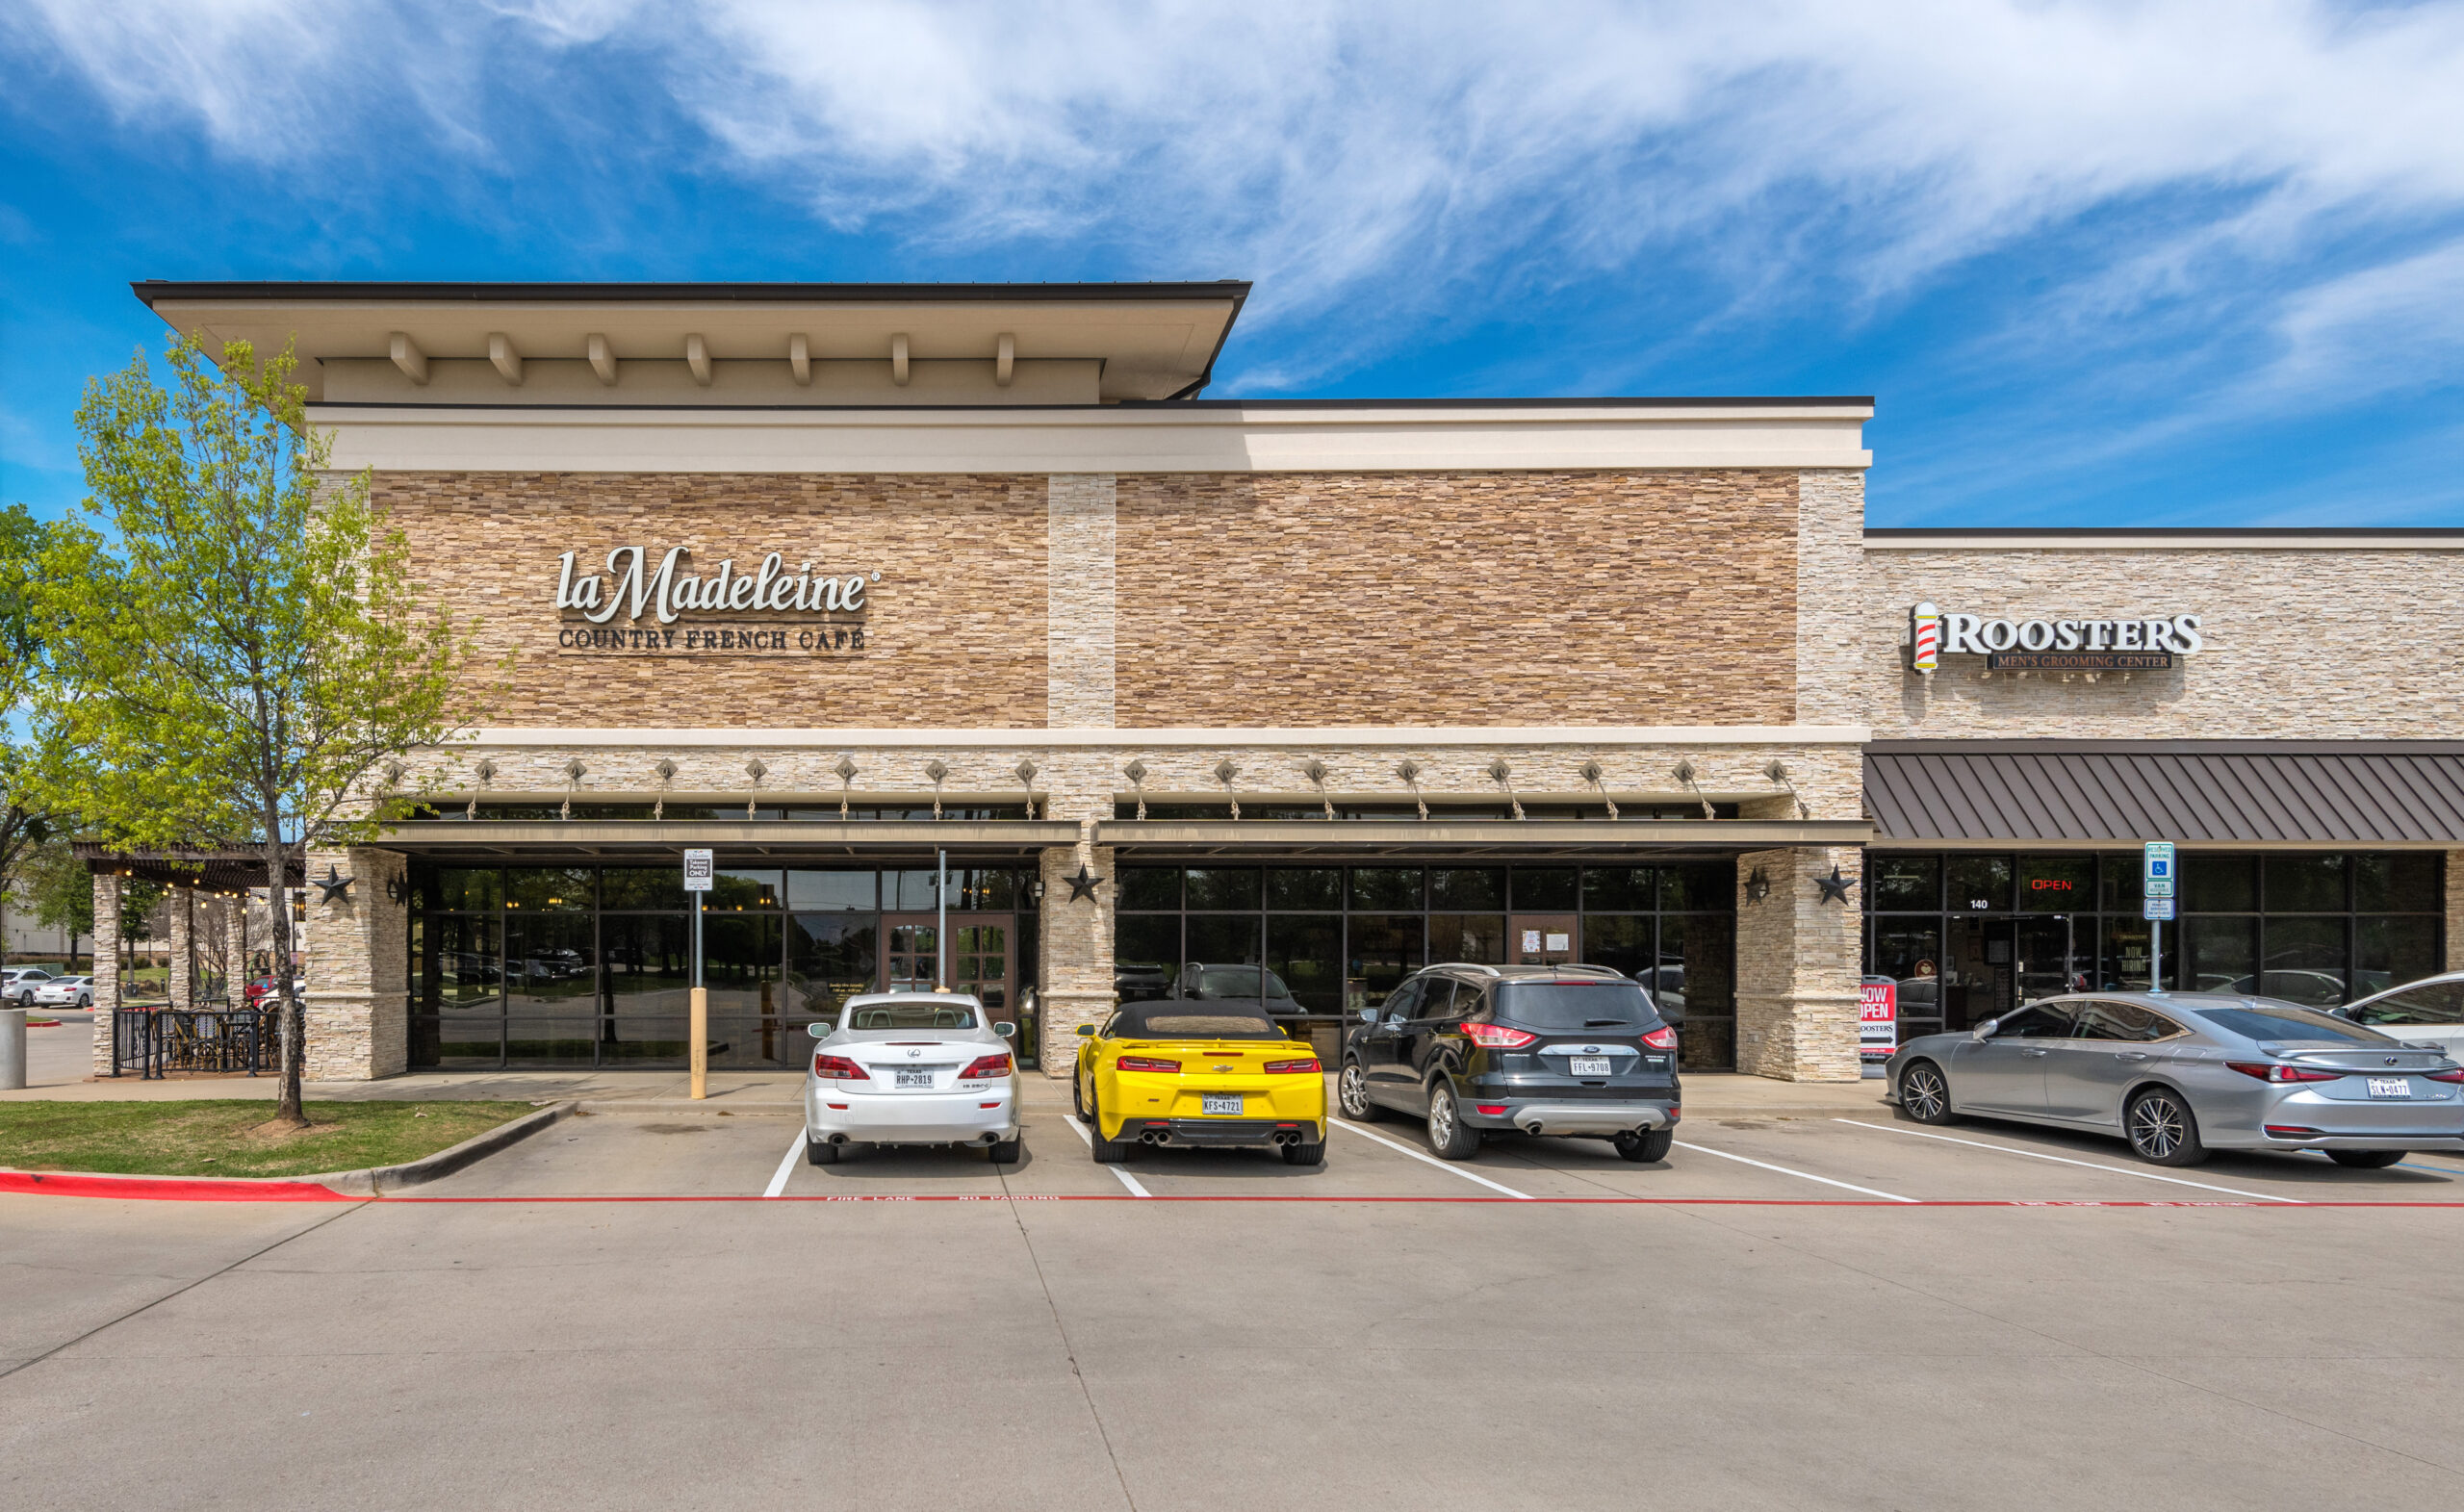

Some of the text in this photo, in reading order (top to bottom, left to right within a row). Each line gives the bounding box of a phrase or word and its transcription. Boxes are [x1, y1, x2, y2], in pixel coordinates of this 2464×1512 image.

[556, 550, 602, 609] la
[583, 545, 865, 624] Madeleine
[558, 627, 865, 650] COUNTRY FRENCH CAFÉ
[1943, 613, 2202, 653] ROOSTERS
[1998, 655, 2169, 667] MEN'S GROOMING CENTER
[2032, 880, 2072, 890] OPEN
[1970, 900, 1989, 909] 140
[2125, 946, 2143, 959] NOW
[2121, 960, 2146, 972] HIRING
